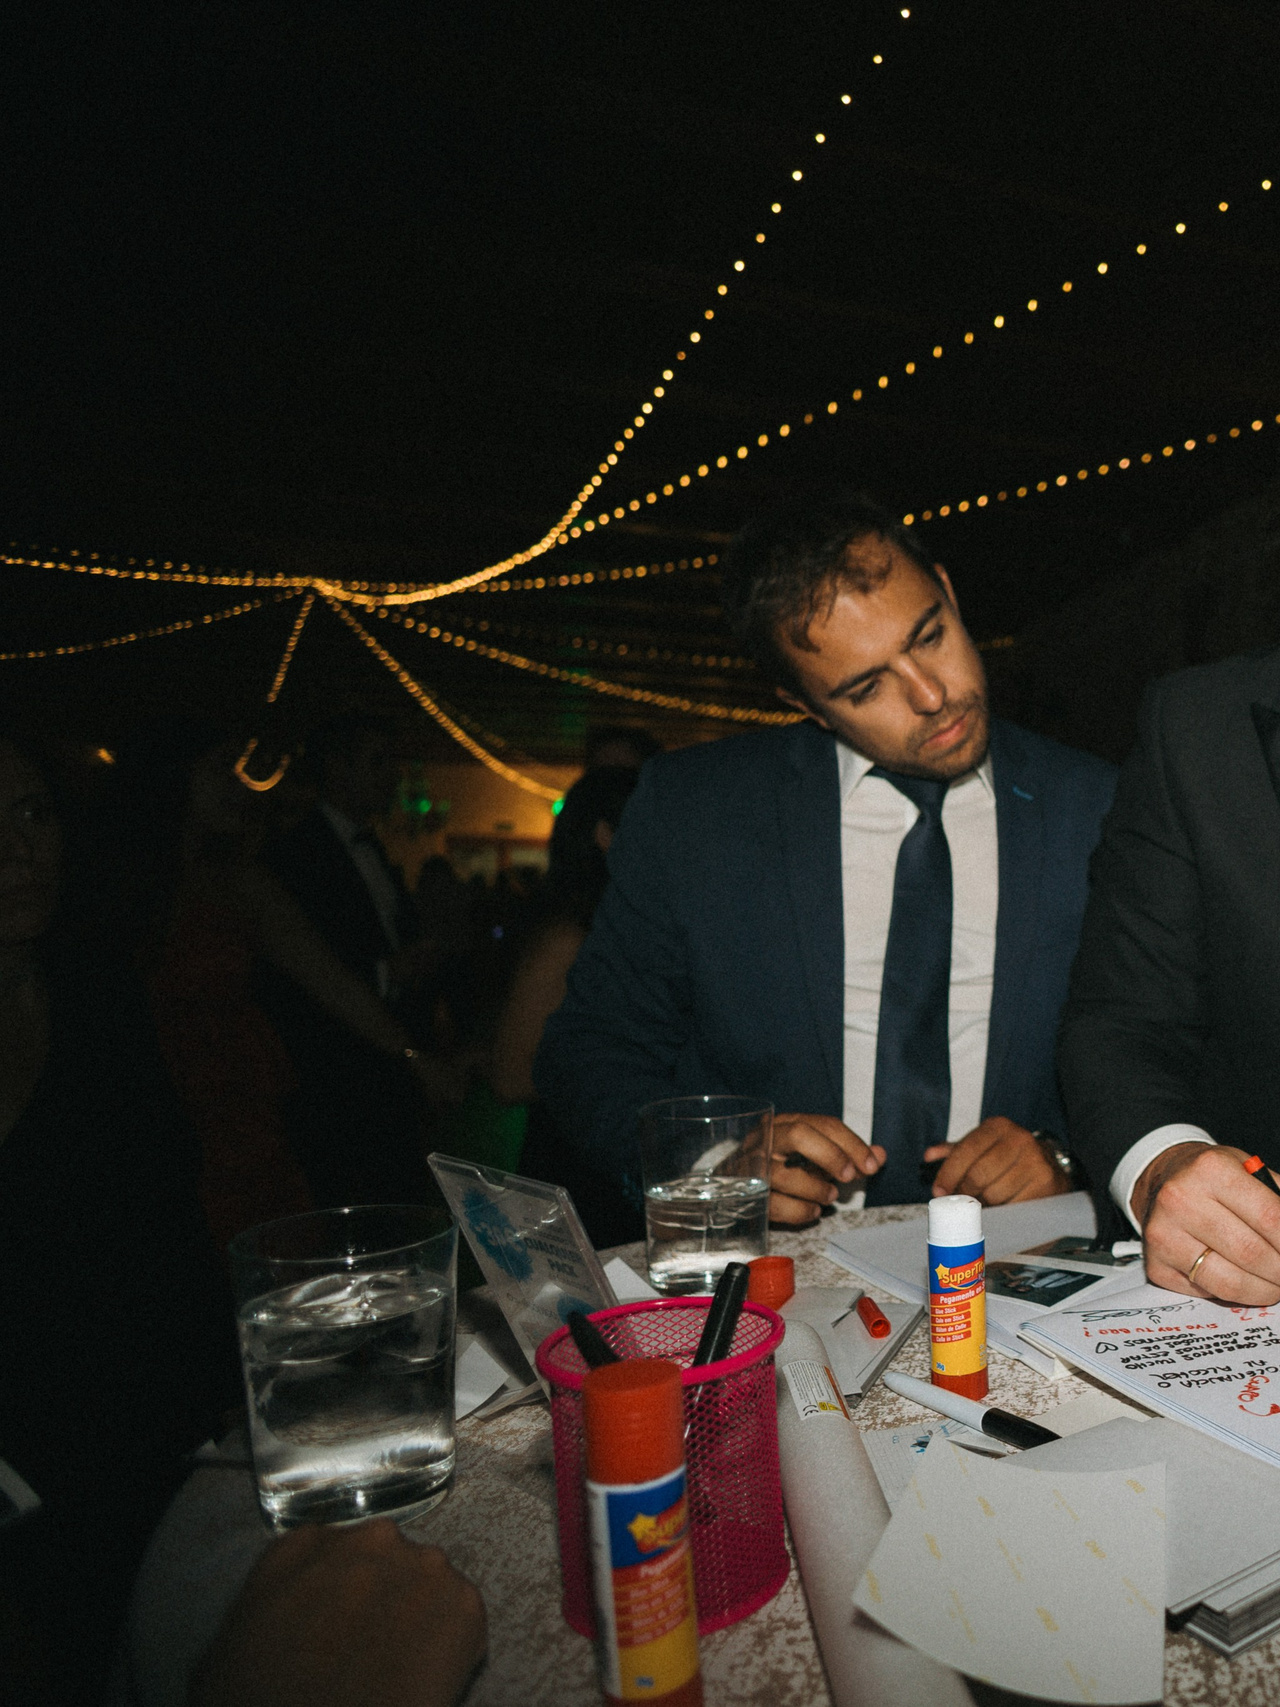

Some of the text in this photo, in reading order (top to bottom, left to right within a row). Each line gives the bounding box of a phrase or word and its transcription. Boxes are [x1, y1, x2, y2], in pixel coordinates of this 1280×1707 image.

[1140, 1344, 1161, 1352] DE
[1175, 1338, 1238, 1355] PODEMOS
[1120, 1351, 1170, 1364] ESTAR
[1125, 1358, 1176, 1370] MUCHO
